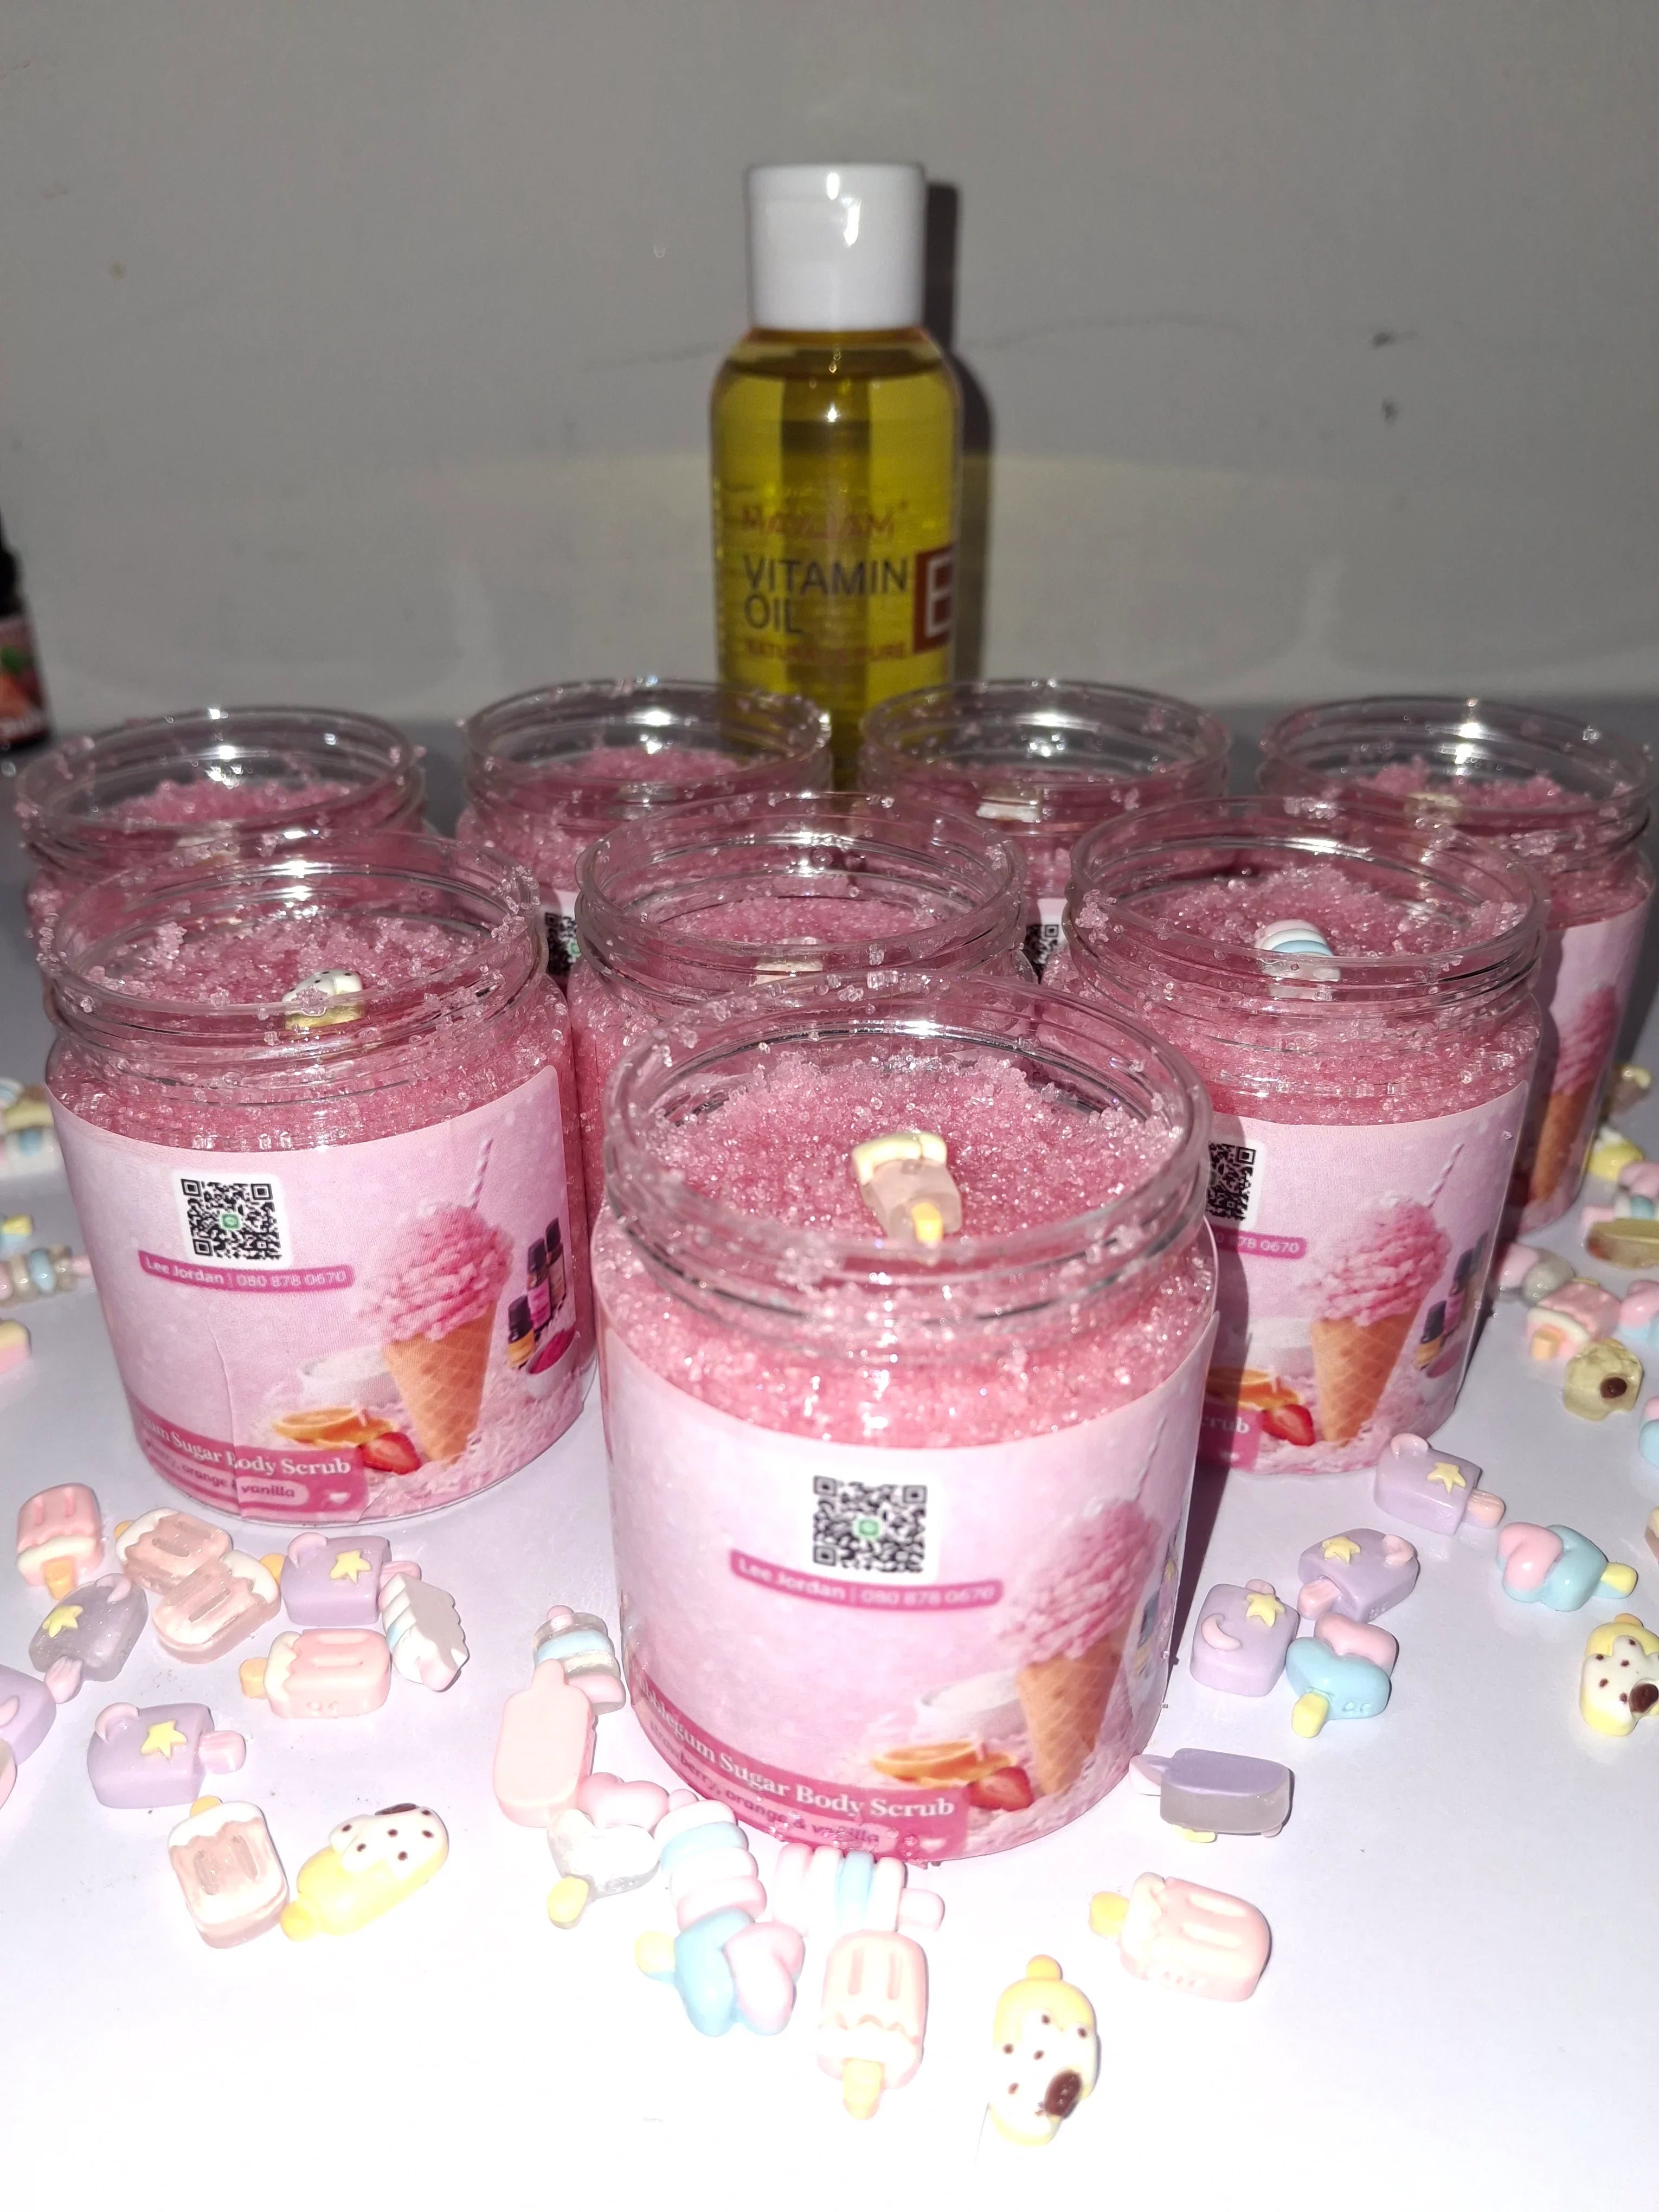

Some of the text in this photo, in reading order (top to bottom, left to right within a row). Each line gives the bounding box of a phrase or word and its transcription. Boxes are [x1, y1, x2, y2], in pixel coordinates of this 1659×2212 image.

[743, 552, 909, 595] VITAMIN
[744, 591, 804, 635] OIL
[926, 553, 954, 639] E
[1260, 1239, 1300, 1253] 0670
[145, 1256, 170, 1276] Lee
[173, 1265, 224, 1285] Jordan
[236, 1274, 266, 1288] 080
[272, 1274, 301, 1288] 878
[305, 1271, 346, 1287] 0670
[171, 1431, 223, 1462] Sugar
[280, 1457, 352, 1475] Scrub
[182, 1464, 227, 1487] orange
[242, 1483, 296, 1498] vanilla
[738, 1558, 774, 1581] Lee
[776, 1571, 846, 1600] Jordan
[861, 1589, 900, 1605] 080
[903, 1590, 941, 1606] 878
[944, 1586, 995, 1604] 0670
[719, 1752, 791, 1797] Sugar
[795, 1784, 865, 1817] Body
[870, 1797, 955, 1818] Scrub
[725, 1790, 787, 1823] orange
